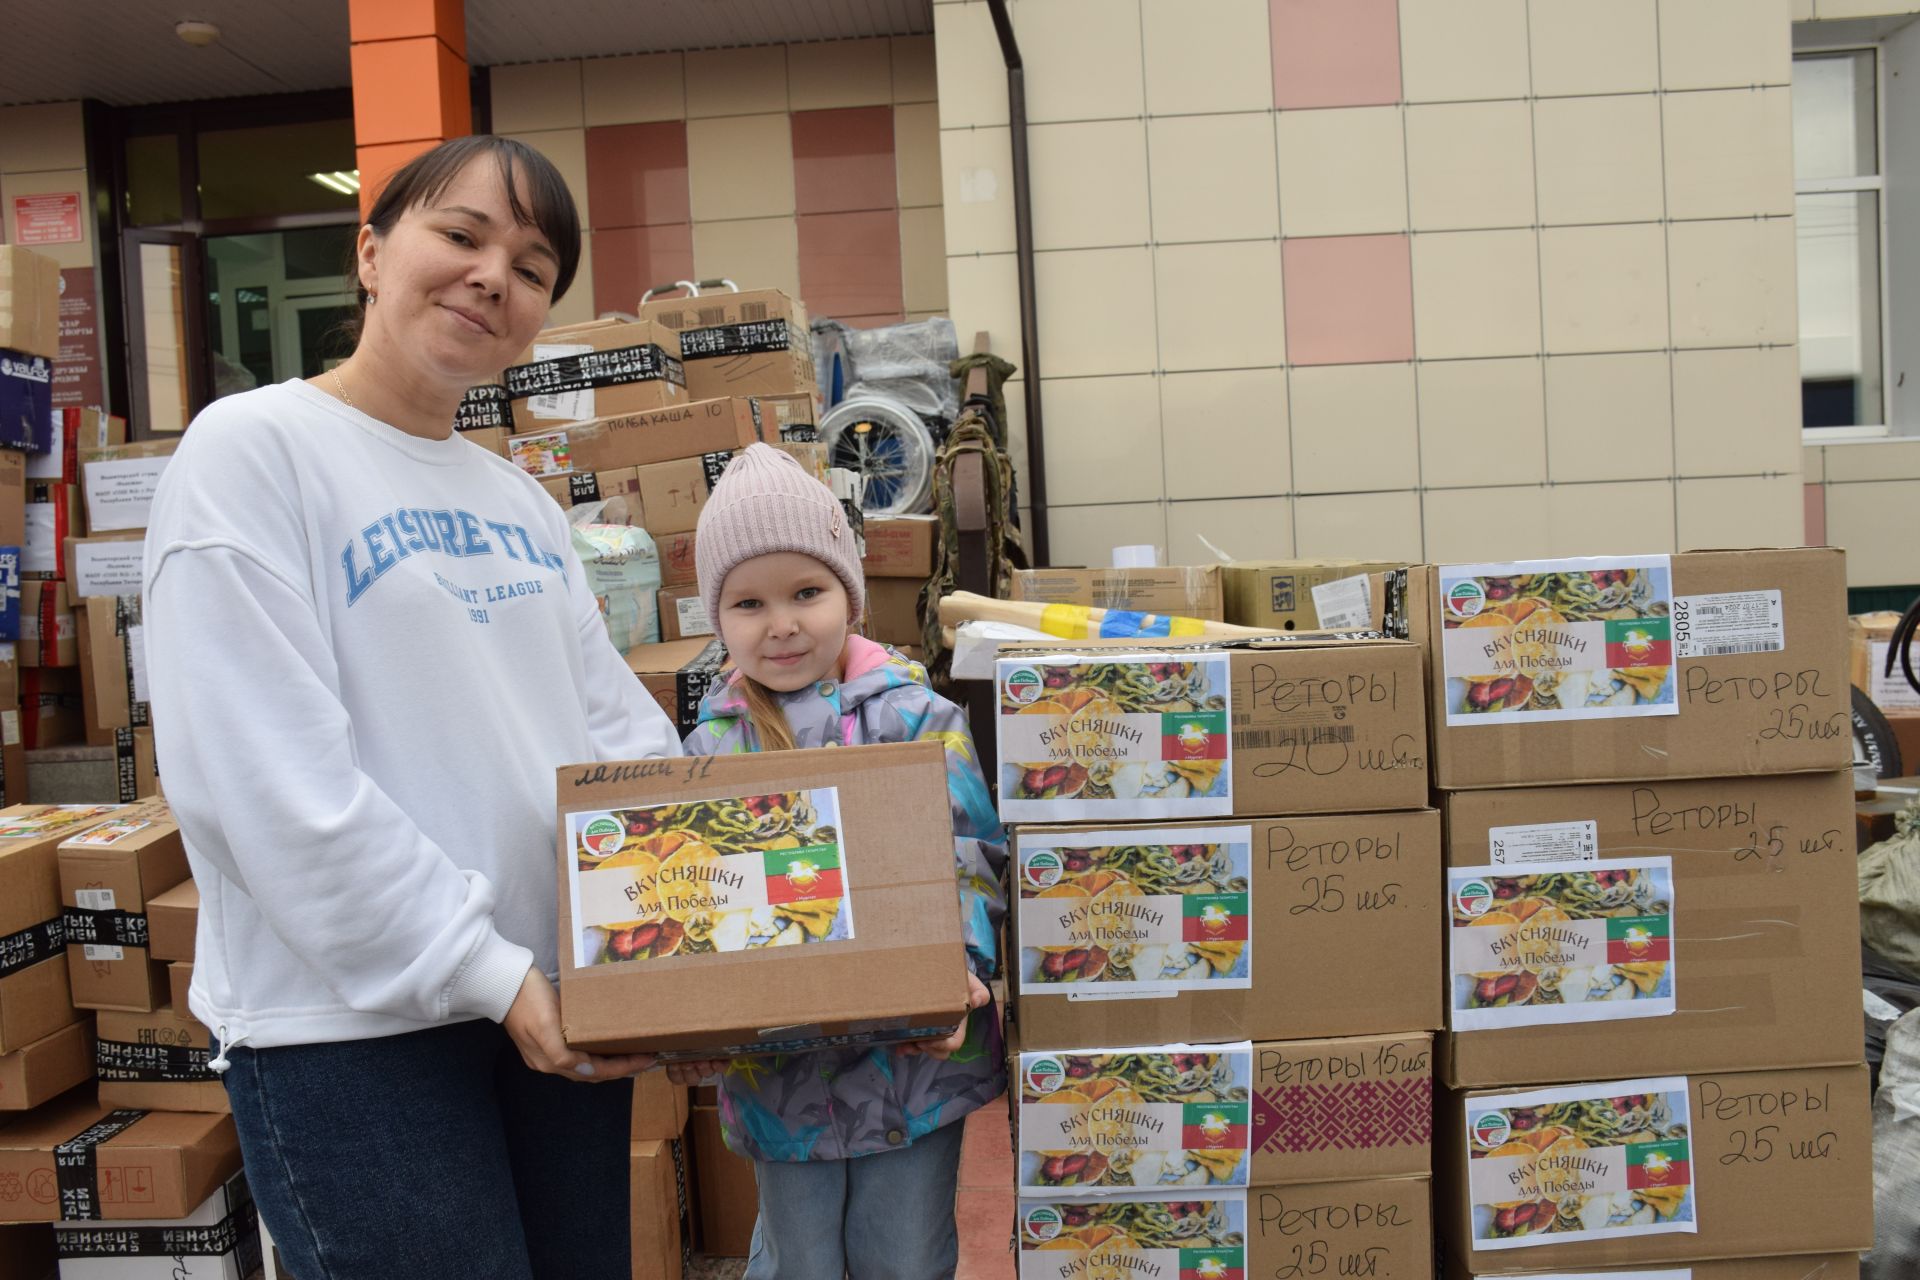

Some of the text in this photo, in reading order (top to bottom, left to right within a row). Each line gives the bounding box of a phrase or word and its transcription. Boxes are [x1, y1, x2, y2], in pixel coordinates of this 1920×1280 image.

[651, 409, 694, 427] КАША
[705, 403, 722, 418] 10
[341, 508, 494, 608] LEISURE
[486, 580, 544, 603] LEAGUE
[468, 608, 490, 624] 1991
[1673, 601, 1691, 642] 2805
[1483, 629, 1588, 659] ВКУСНЯШКИ
[1493, 653, 1573, 674] для Победы
[1251, 663, 1397, 713] Реторы
[1039, 720, 1144, 746] ВКУСНЯШКИ
[1048, 742, 1129, 762] для Победы
[1252, 733, 1348, 778] 20
[1632, 788, 1757, 836] Реторы
[1267, 825, 1401, 873] Реторы
[624, 865, 744, 902] ВКУСНЯШКИ
[1289, 874, 1345, 915] 25
[636, 894, 729, 918] для Победы
[1059, 901, 1164, 929] ВКУСНЯШКИ
[1068, 925, 1149, 944] для Победы
[1490, 926, 1590, 956] ВКУСНЯШКИ
[1499, 949, 1576, 969] для Победы
[1259, 1049, 1366, 1084] Реторы
[1698, 1080, 1830, 1121] Реторы
[1059, 1107, 1164, 1135] ВКУСНЯШКИ
[1068, 1131, 1149, 1149] для Победы
[1719, 1125, 1779, 1166] 25
[1508, 1157, 1609, 1186] ВКУСНЯШКИ
[1517, 1178, 1595, 1198] для Победы
[1058, 1253, 1162, 1279] ВКУСНЯШКИ
